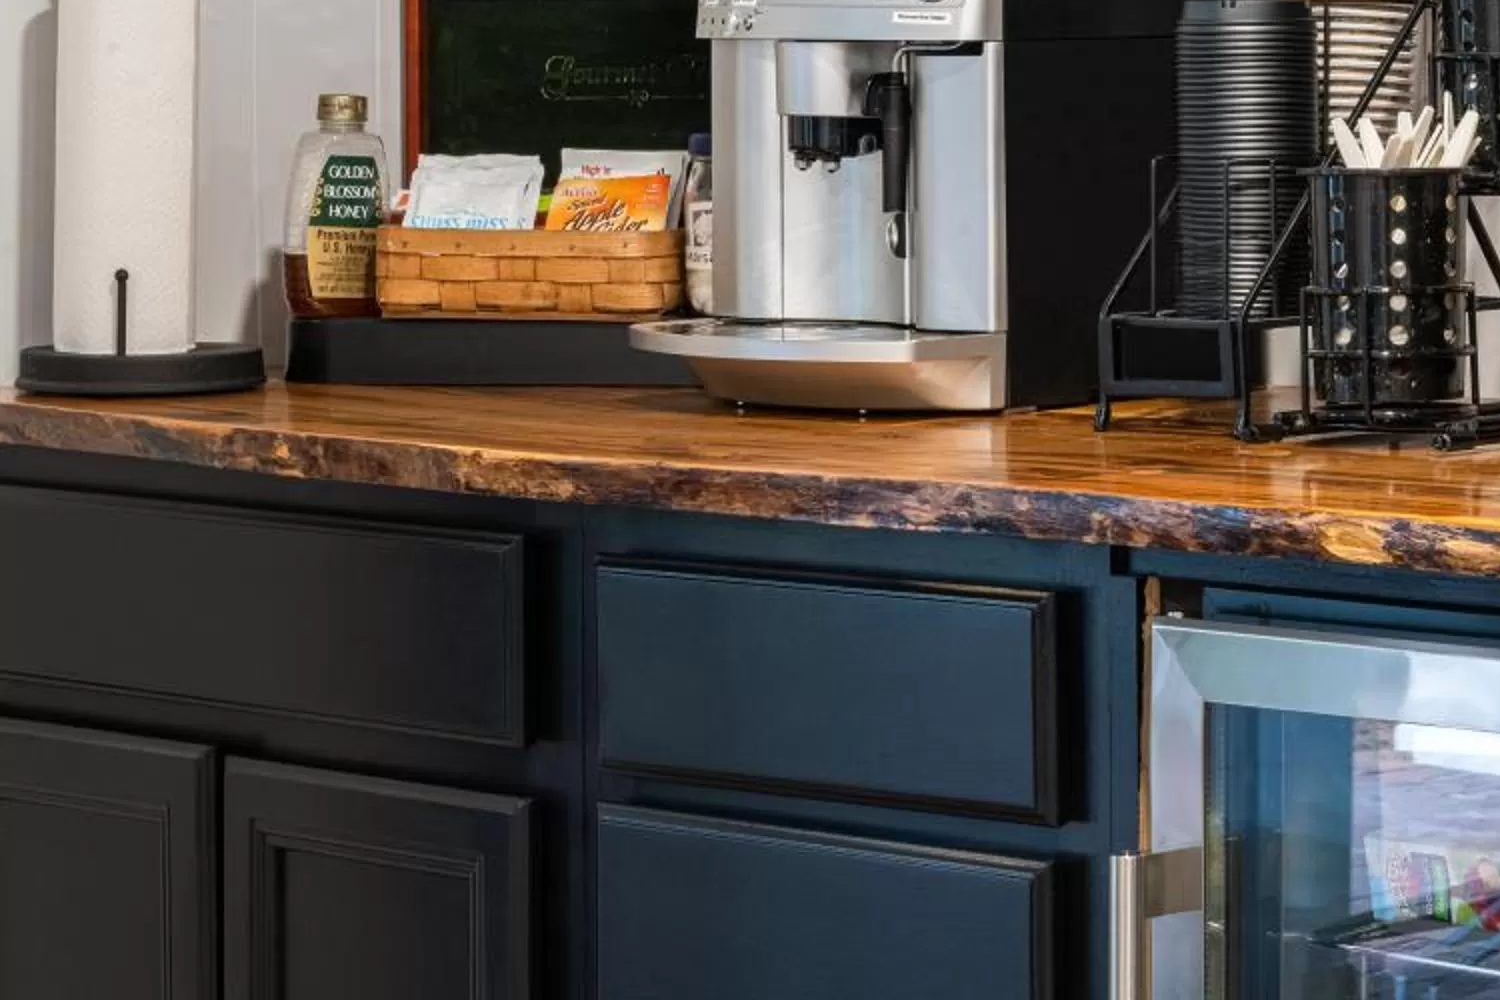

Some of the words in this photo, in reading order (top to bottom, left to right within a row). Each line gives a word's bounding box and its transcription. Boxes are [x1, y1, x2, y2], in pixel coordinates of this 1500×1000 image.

[328, 165, 374, 179] GOLDEN
[323, 185, 376, 199] BLOSSOM
[328, 203, 370, 219] HONEY
[561, 198, 627, 232] Apple
